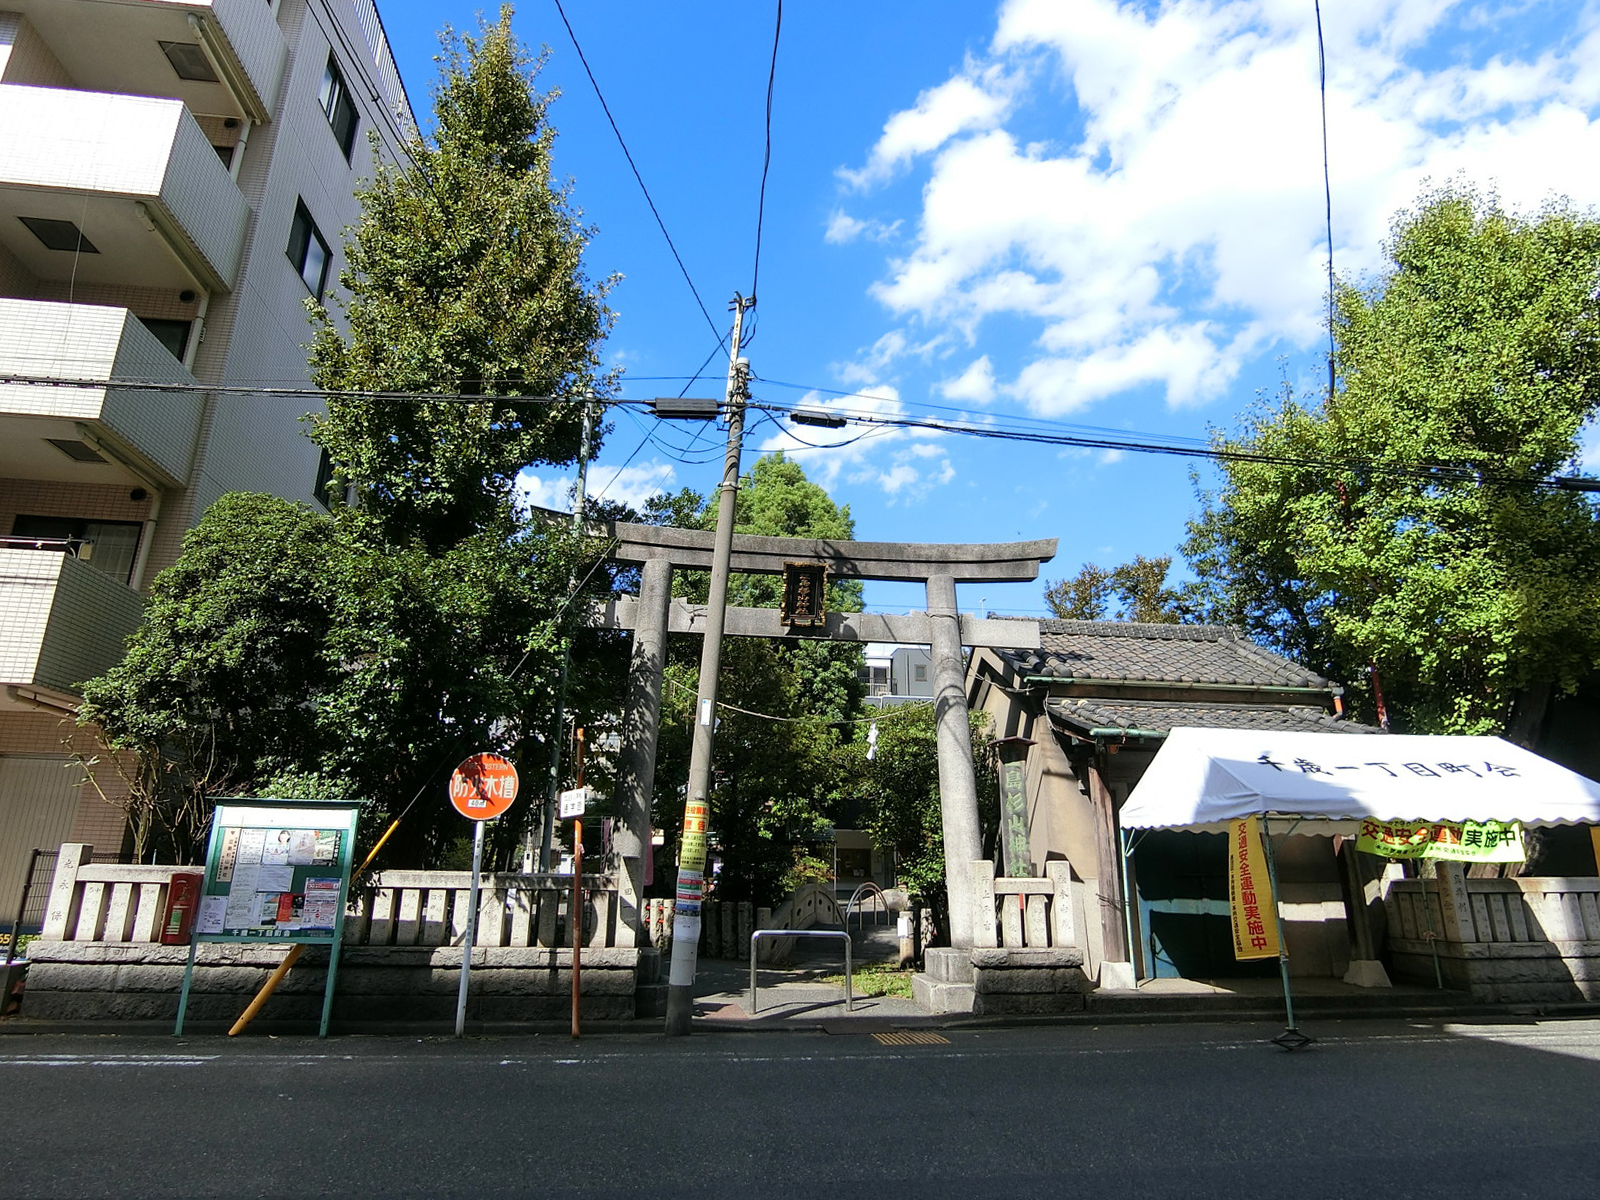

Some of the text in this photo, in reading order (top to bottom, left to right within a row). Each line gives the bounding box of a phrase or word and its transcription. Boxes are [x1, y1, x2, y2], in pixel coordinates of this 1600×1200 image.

[1257, 752, 1521, 778] 千歳一丁目町会
[453, 773, 515, 798] 防火水槽
[1361, 819, 1516, 849] 交通安全運動実施中
[1238, 821, 1267, 951] 交通安全運動実施中
